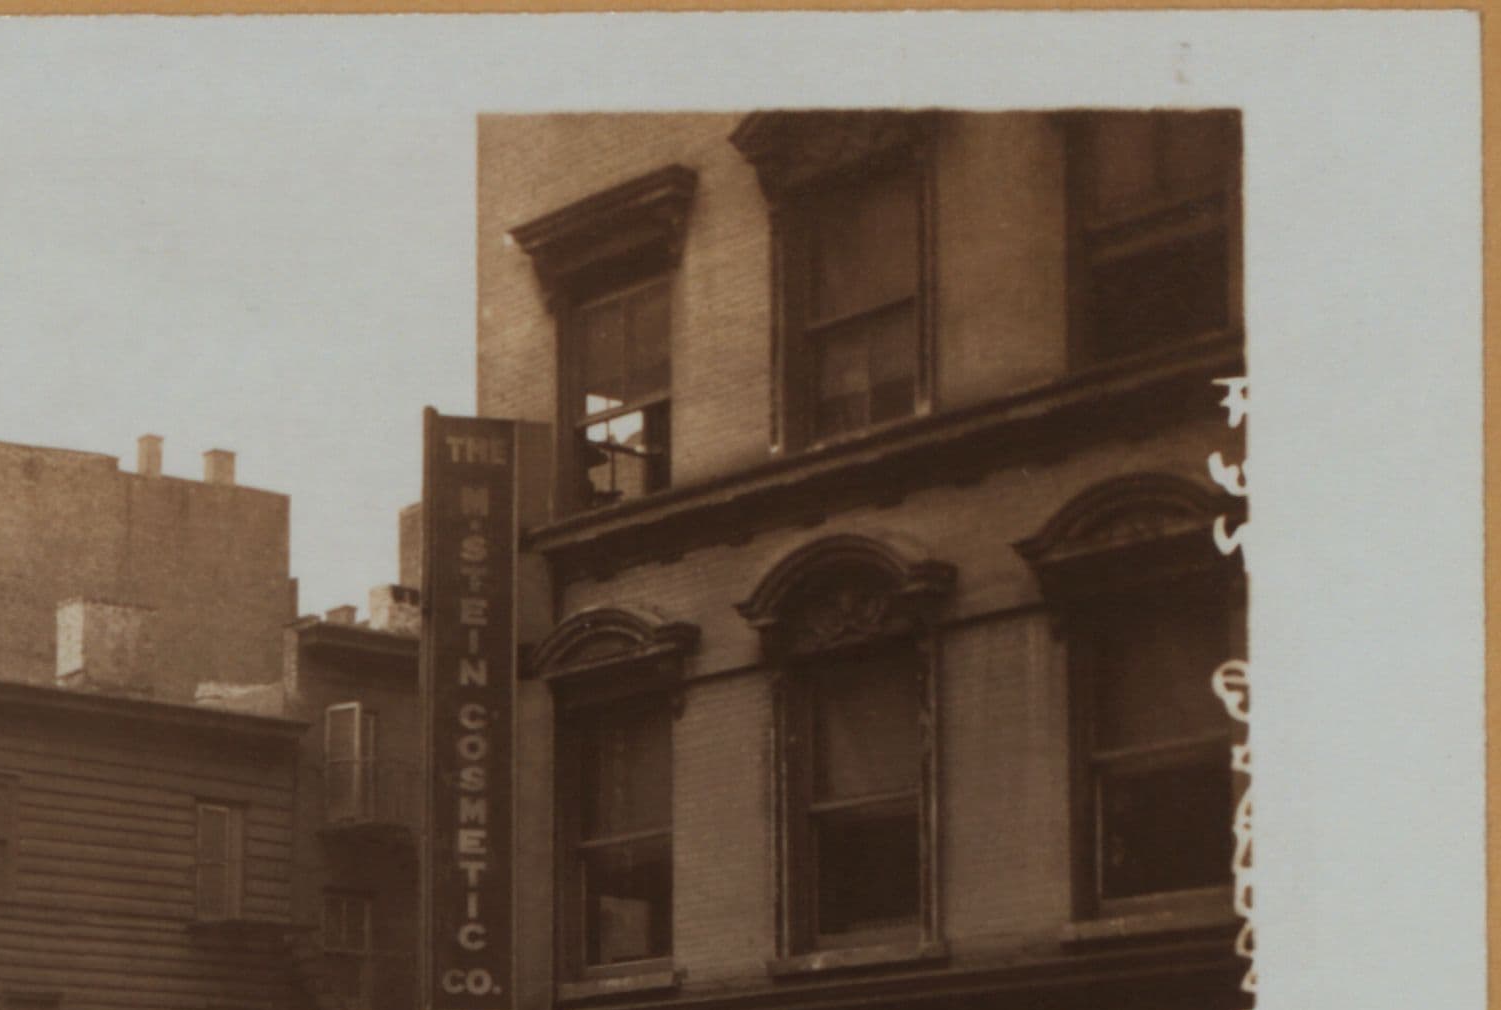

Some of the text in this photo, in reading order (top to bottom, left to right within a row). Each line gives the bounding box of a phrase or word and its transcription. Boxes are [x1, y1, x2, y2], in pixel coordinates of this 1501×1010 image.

[445, 435, 508, 466] THE
[457, 704, 488, 950] COSMETIC
[442, 968, 502, 996] CO.
